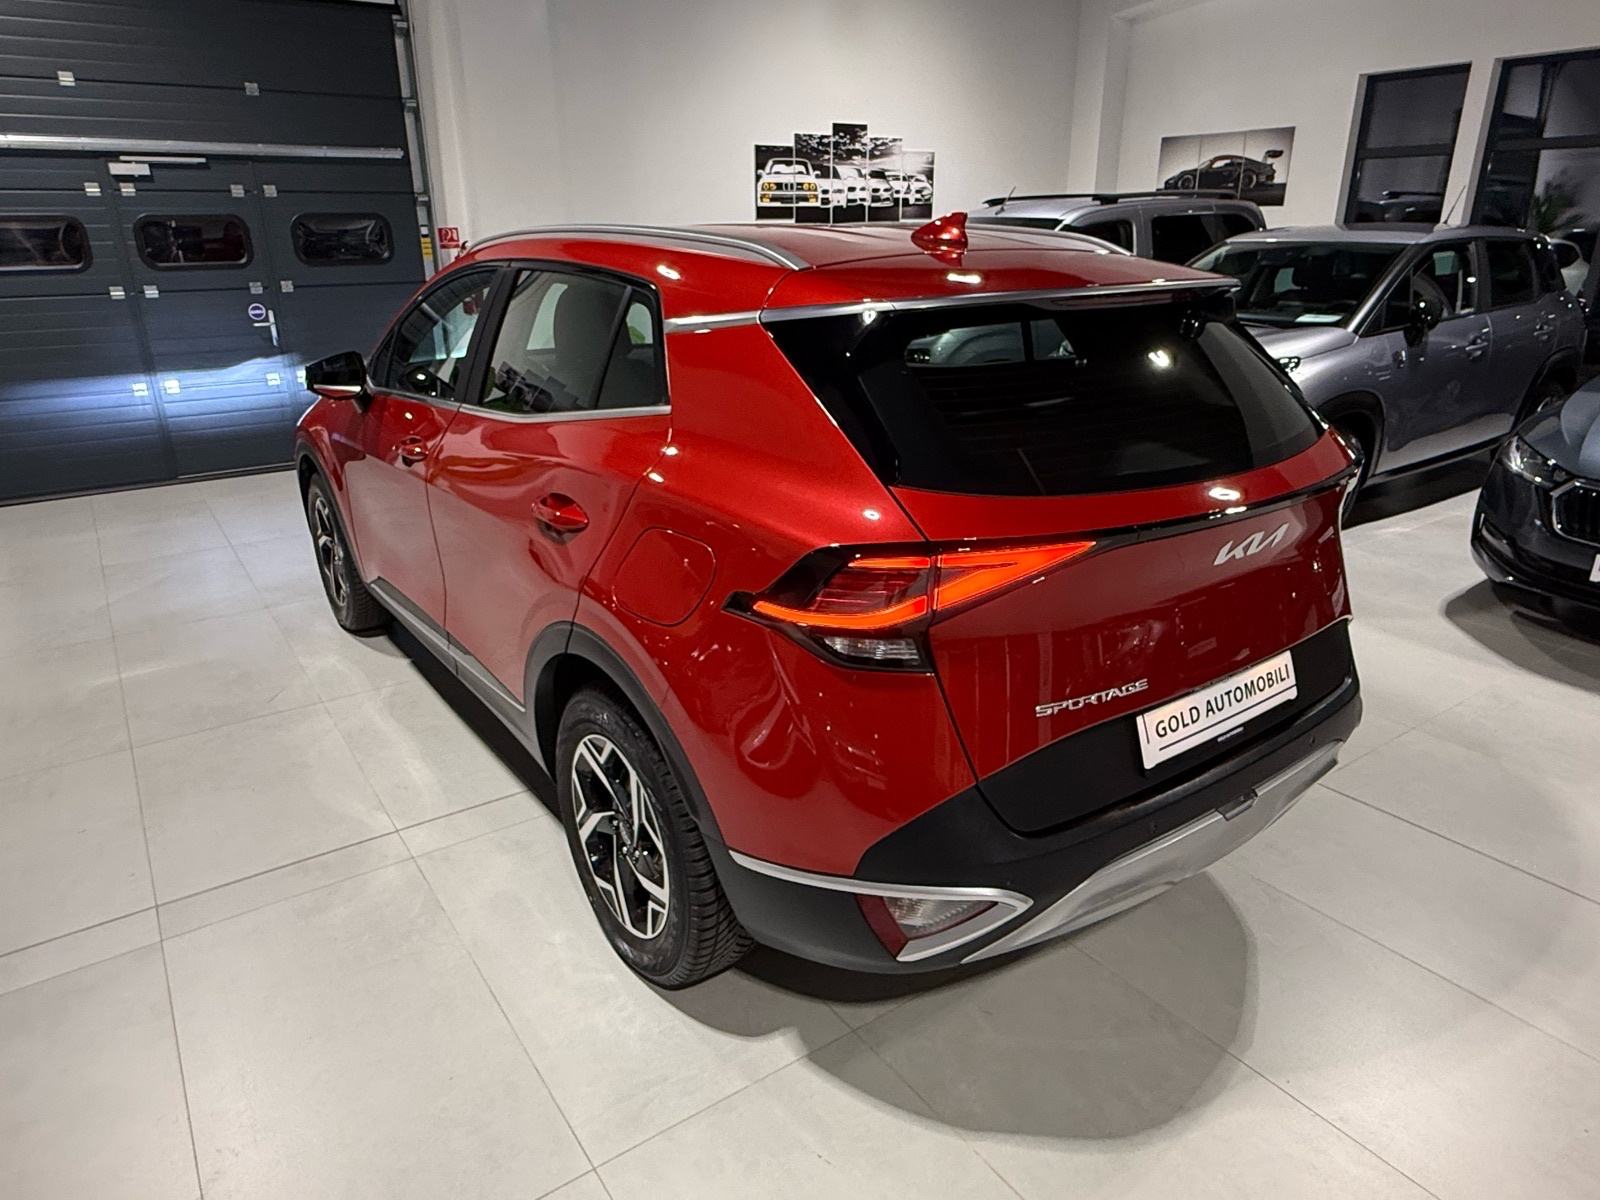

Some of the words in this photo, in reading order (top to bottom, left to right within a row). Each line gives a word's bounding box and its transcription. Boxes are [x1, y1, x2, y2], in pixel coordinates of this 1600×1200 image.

[1213, 522, 1289, 566] KIA
[1035, 678, 1149, 717] SPORTAGE
[1155, 706, 1200, 738] GOLD
[1205, 663, 1290, 718] AUTOMOBILI
